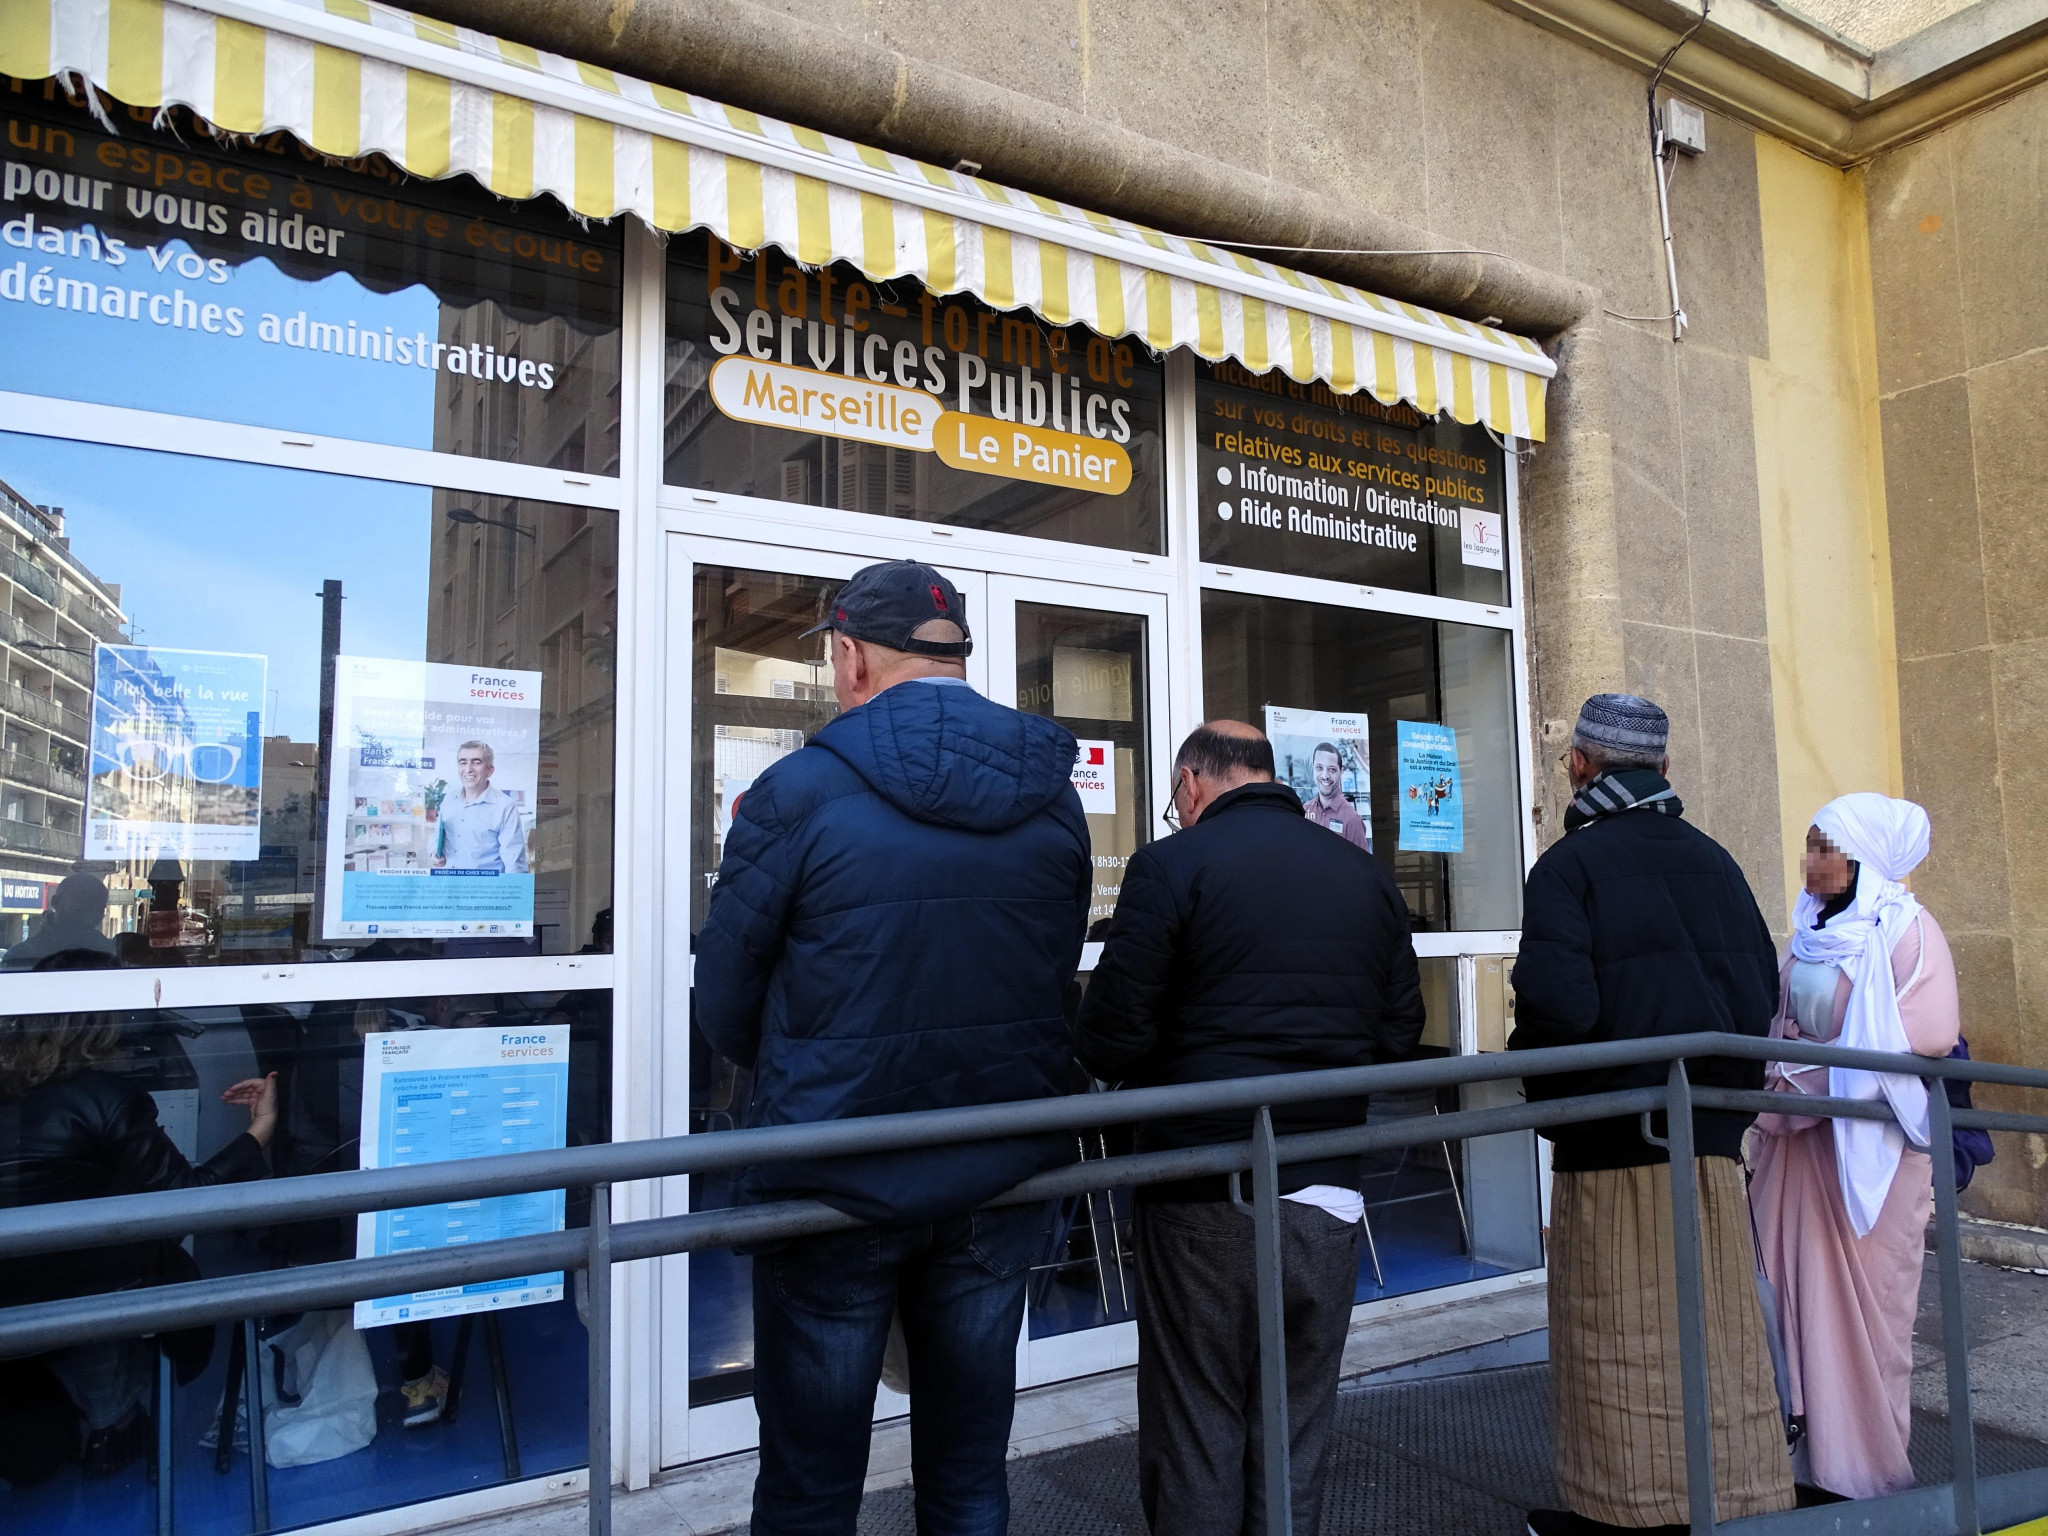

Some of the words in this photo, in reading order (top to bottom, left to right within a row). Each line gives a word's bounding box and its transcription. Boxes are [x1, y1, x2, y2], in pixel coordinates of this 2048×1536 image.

[9, 120, 75, 158] un
[96, 141, 270, 200] espace
[289, 176, 313, 211] à
[333, 190, 449, 239] votre
[465, 214, 604, 273] écoute
[3, 161, 112, 212] pour
[125, 186, 228, 236] vous
[240, 207, 346, 257] aider
[2, 212, 126, 267] dans
[146, 245, 230, 285] vos
[0, 261, 245, 338] démarches
[258, 307, 555, 391] administratives
[709, 286, 946, 395] Services
[958, 351, 1131, 444] Publics
[1087, 328, 1134, 389] de
[743, 369, 922, 437] Marseille
[1214, 399, 1247, 421] sur
[1253, 407, 1285, 431] vos
[1292, 412, 1346, 444] droits
[1352, 428, 1371, 450] et
[1377, 430, 1400, 455] les
[1406, 441, 1487, 475] questions
[958, 422, 1000, 463] Le
[1012, 432, 1118, 484] Panier
[1215, 431, 1302, 466] relatives
[1308, 451, 1342, 474] aux
[1348, 459, 1420, 490] services
[1425, 473, 1484, 504] publics
[1240, 462, 1349, 508] Information
[1366, 487, 1458, 529] Orientation
[1240, 497, 1282, 530] Aide
[1288, 506, 1417, 553] Administrative
[1474, 543, 1500, 557] lagrange
[471, 674, 517, 688] France
[154, 680, 191, 699] belle
[199, 685, 214, 700] la
[221, 690, 249, 702] vue
[470, 688, 525, 701] services
[446, 711, 473, 724] pour
[476, 714, 495, 724] vos
[1331, 717, 1357, 726] France
[431, 722, 519, 738] administratives
[1331, 726, 1361, 734] services
[1411, 732, 1434, 740] Besoin
[1402, 741, 1425, 749] conseil
[363, 757, 393, 766] France
[1072, 770, 1098, 779] ance
[1093, 904, 1102, 916] et
[1103, 903, 1117, 915] 14
[501, 1034, 547, 1045] France
[500, 1046, 554, 1058] services
[393, 1076, 429, 1084] Retrouvez
[393, 1085, 418, 1093] proche
[414, 1291, 436, 1299] PROCHE
